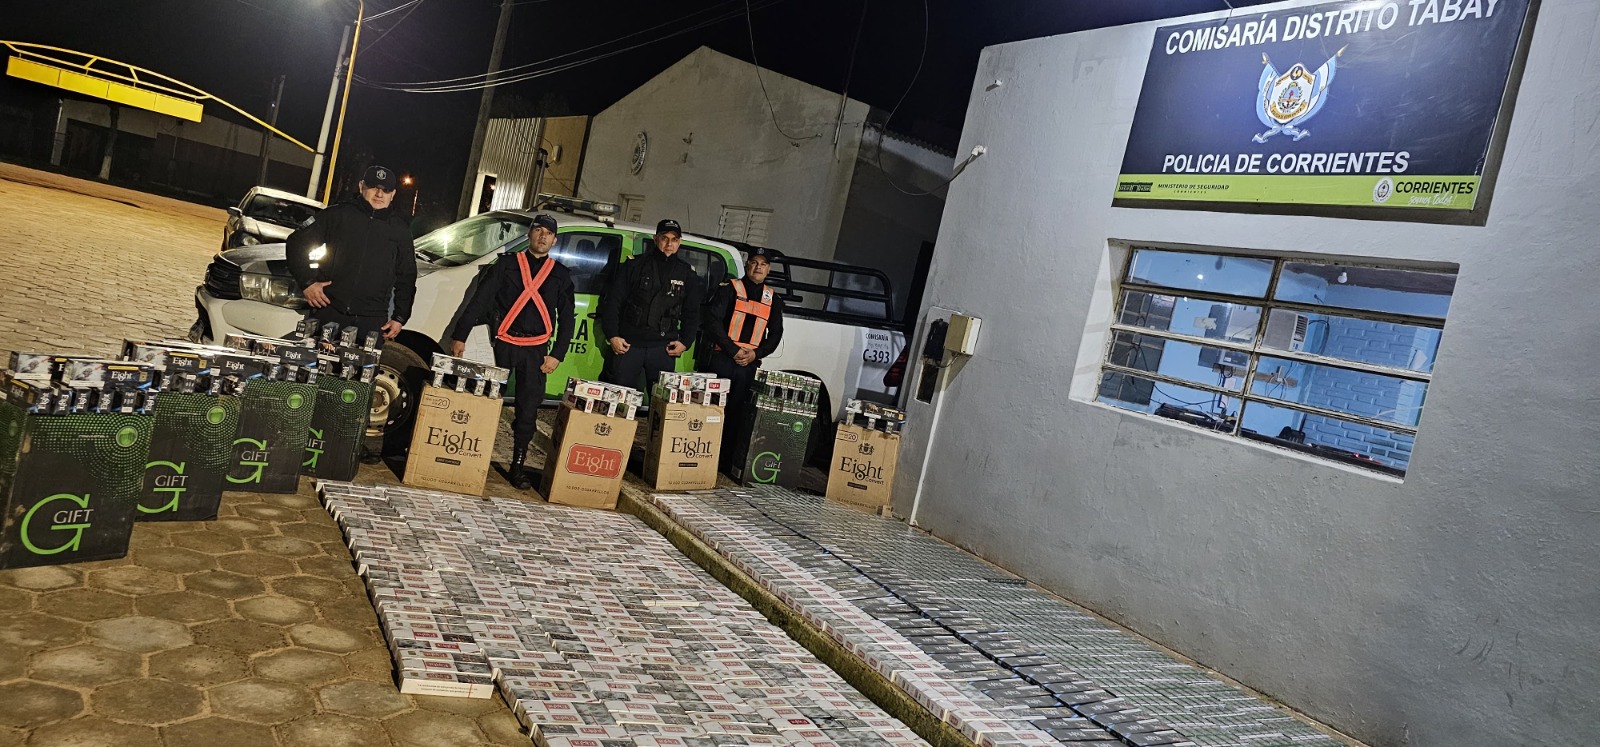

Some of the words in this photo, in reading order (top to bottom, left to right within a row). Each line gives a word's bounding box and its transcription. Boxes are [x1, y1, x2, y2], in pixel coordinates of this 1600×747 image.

[1166, 14, 1277, 54] COMISARÍA
[1282, 3, 1399, 42] DISTRITO
[1408, 0, 1500, 26] TABAY
[1162, 154, 1230, 173] POLICIA
[1235, 154, 1262, 173] DE
[1266, 151, 1410, 173] CORRIENTES
[1395, 182, 1474, 194] CORRIENTES
[172, 357, 192, 366] Eight
[863, 349, 890, 364] C-393
[226, 361, 244, 370] Eight
[111, 371, 132, 381] Eight
[424, 426, 482, 454] Eight
[670, 437, 712, 458] Eight
[241, 451, 270, 462] GIFT
[573, 451, 616, 473] Eight
[765, 460, 782, 468] GIFT
[839, 456, 884, 480] Eight
[154, 474, 188, 486] GIFT
[21, 494, 90, 554] G
[53, 509, 94, 524] GIFT
